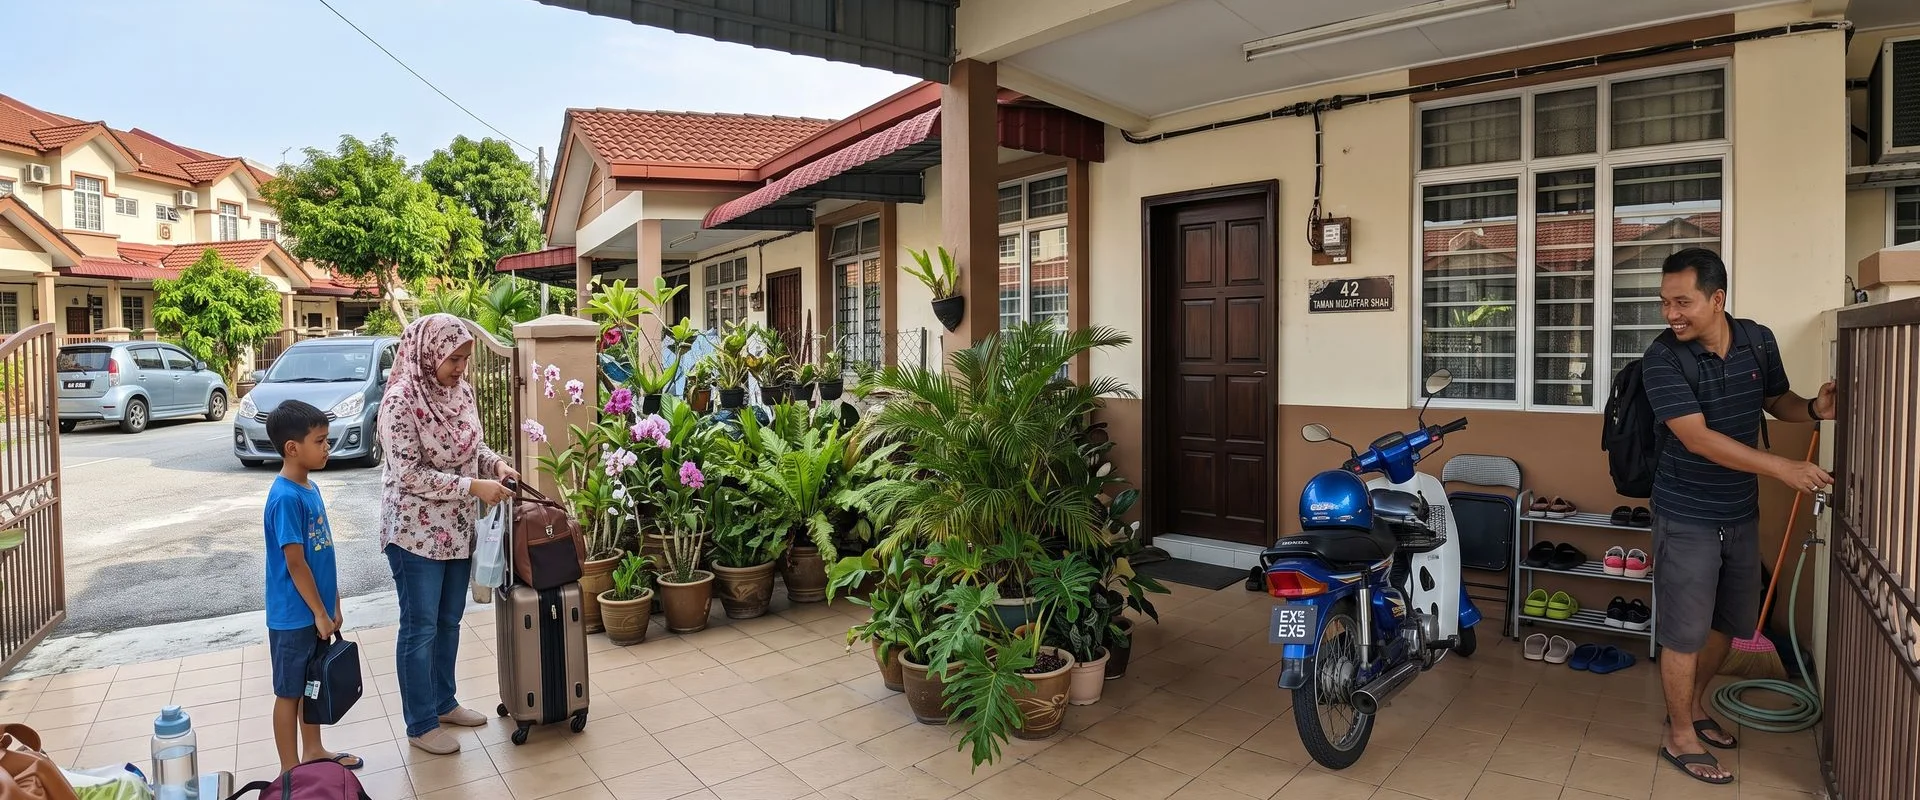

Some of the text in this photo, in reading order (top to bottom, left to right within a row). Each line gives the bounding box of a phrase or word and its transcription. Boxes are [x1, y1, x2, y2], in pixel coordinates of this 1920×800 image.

[1340, 281, 1359, 297] 42
[1313, 300, 1334, 309] TAMAN
[1370, 298, 1389, 307] SHAH
[1278, 624, 1306, 638] EX5
